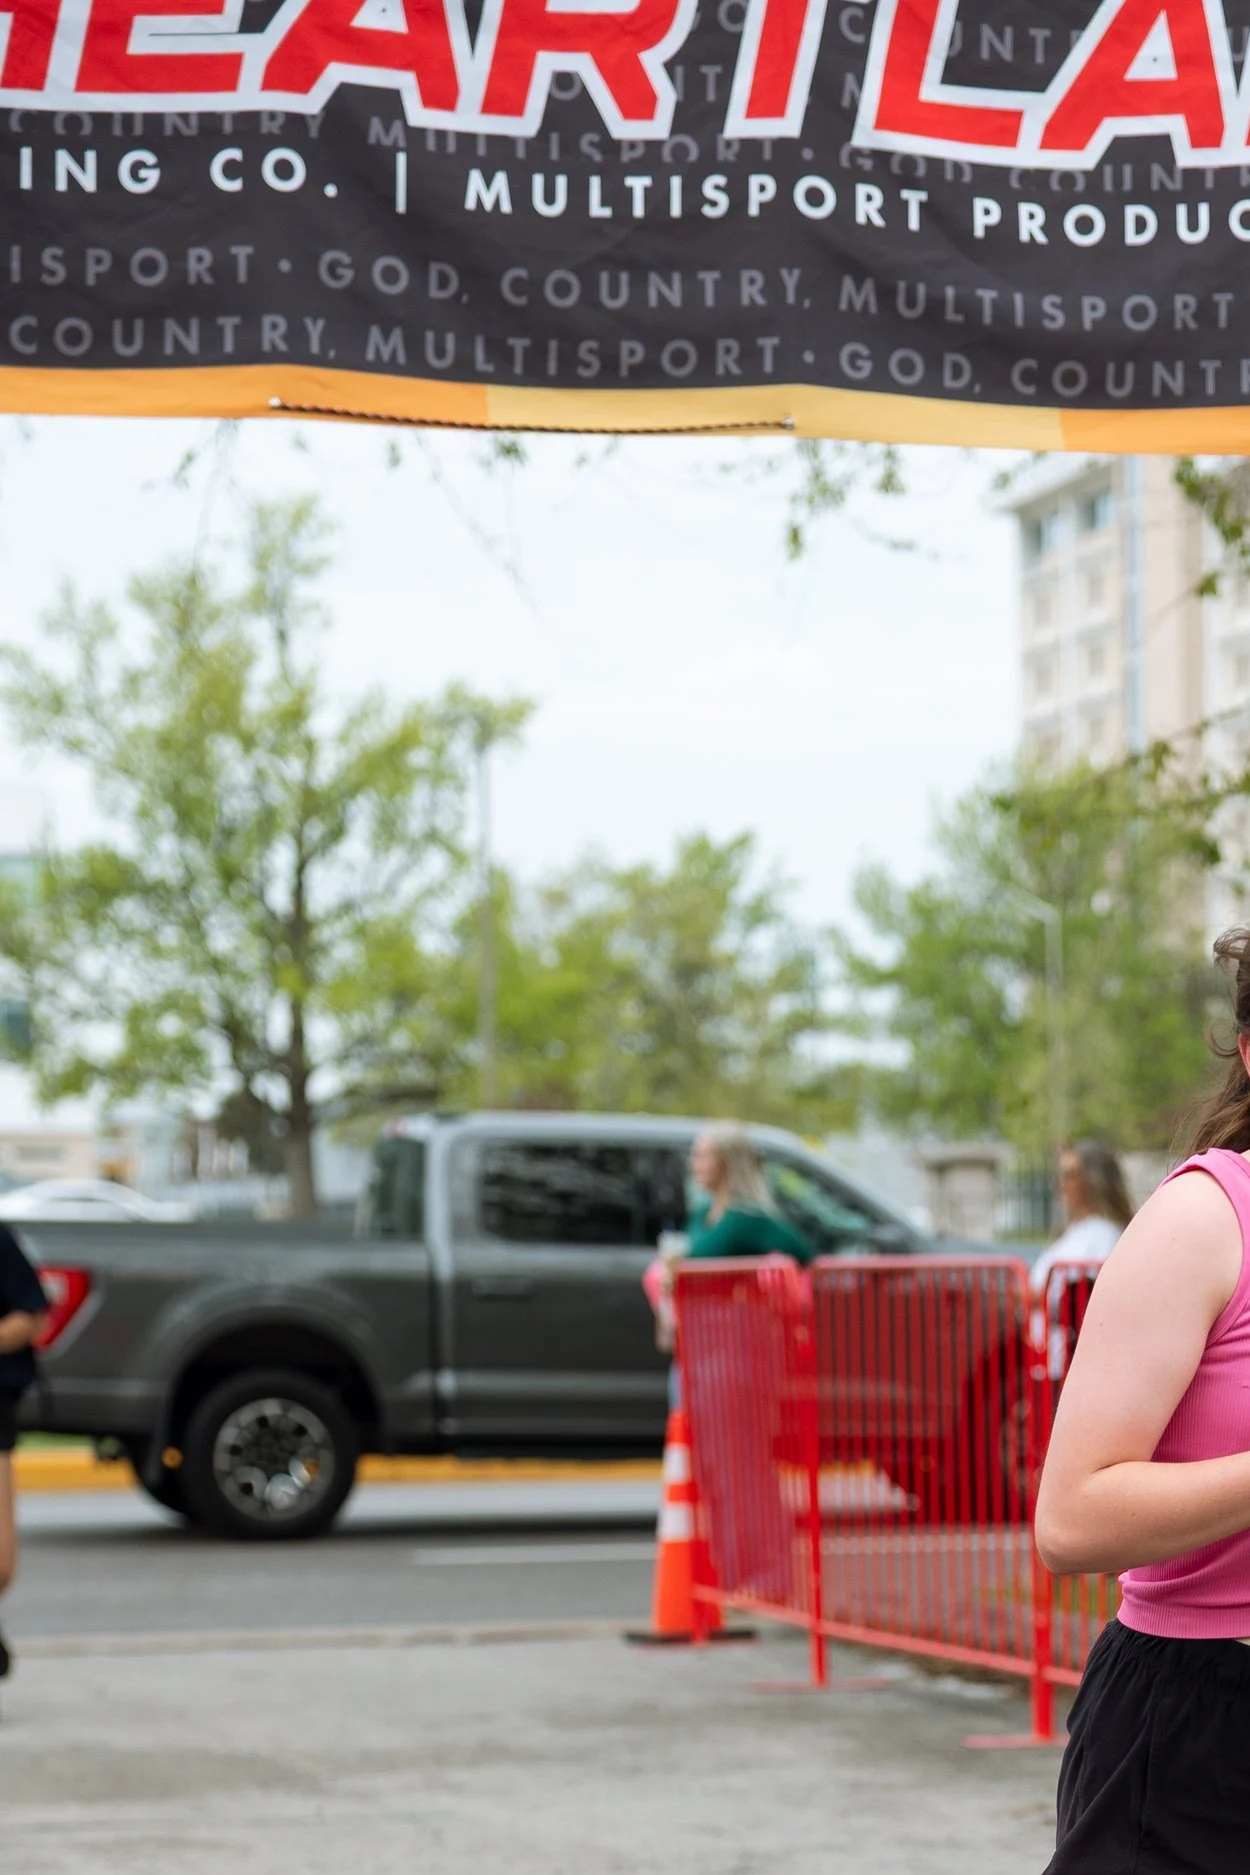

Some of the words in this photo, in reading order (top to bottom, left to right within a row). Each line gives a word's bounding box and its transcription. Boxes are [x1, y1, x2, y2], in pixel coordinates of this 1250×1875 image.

[19, 146, 162, 195] ING
[209, 146, 339, 198] CO.
[463, 167, 929, 233] MULTISPORT
[317, 249, 469, 305] GOD,
[500, 267, 811, 309] COUNTRY,
[837, 274, 1234, 332] MULTISPORT
[9, 313, 337, 361] COUNTRY,
[364, 324, 781, 379] MULTISPORT
[838, 342, 982, 396] GOD,
